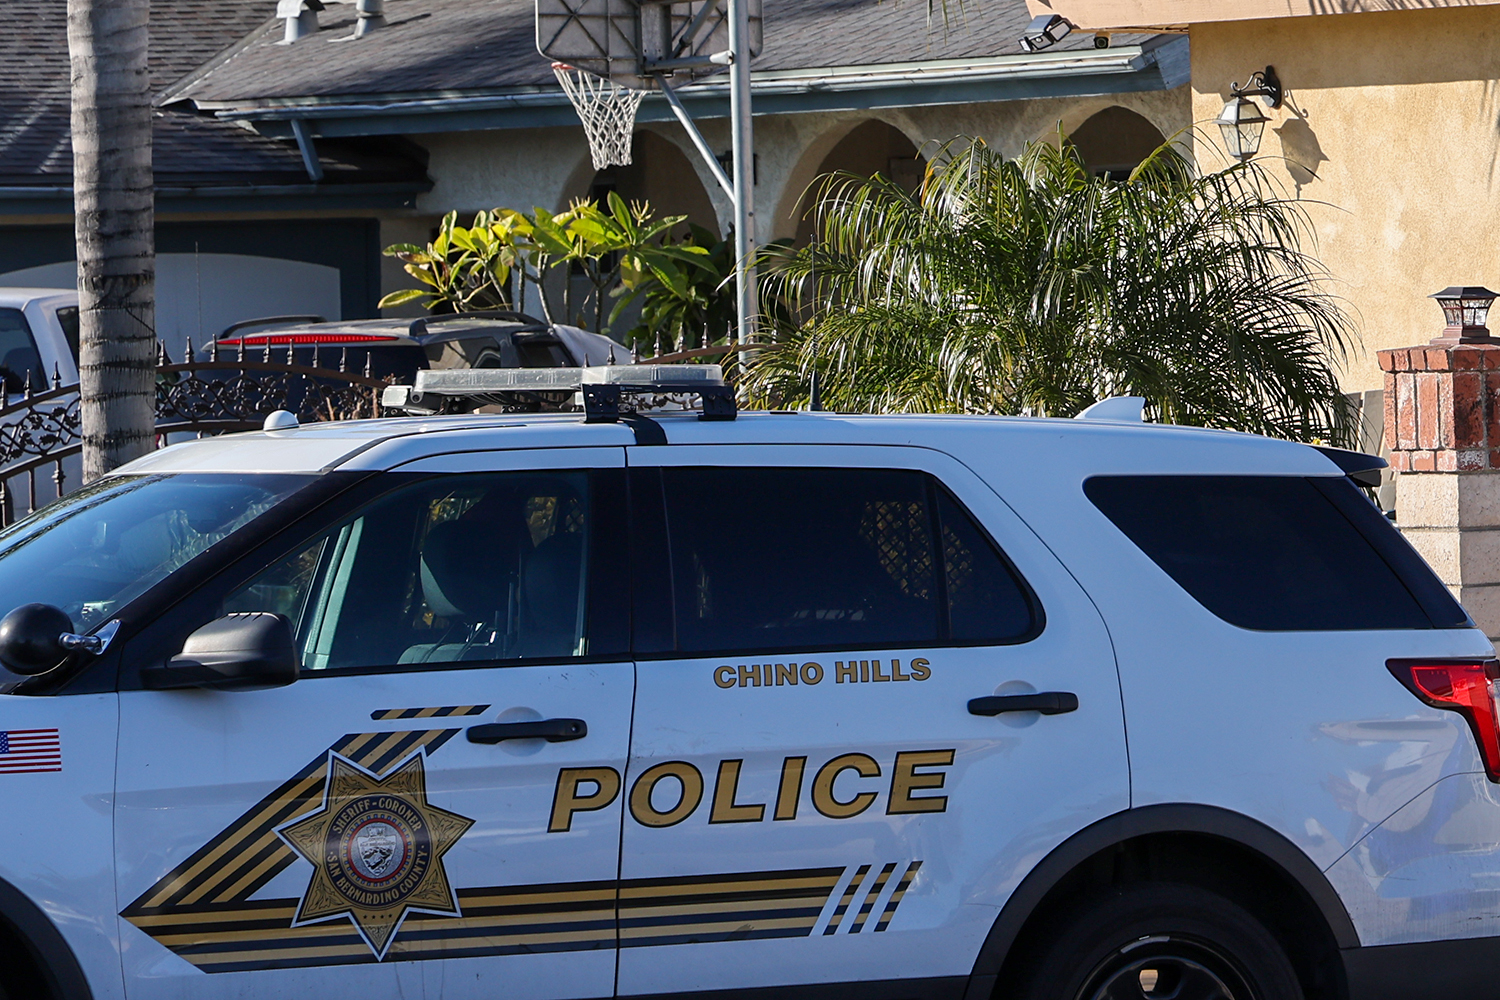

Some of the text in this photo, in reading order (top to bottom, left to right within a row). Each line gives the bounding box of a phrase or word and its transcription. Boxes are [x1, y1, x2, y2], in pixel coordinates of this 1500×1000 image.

[713, 657, 931, 689] CHINO HILLS
[547, 748, 956, 833] POLICE
[327, 850, 428, 905] SAN BERNARDINO COUNTY
